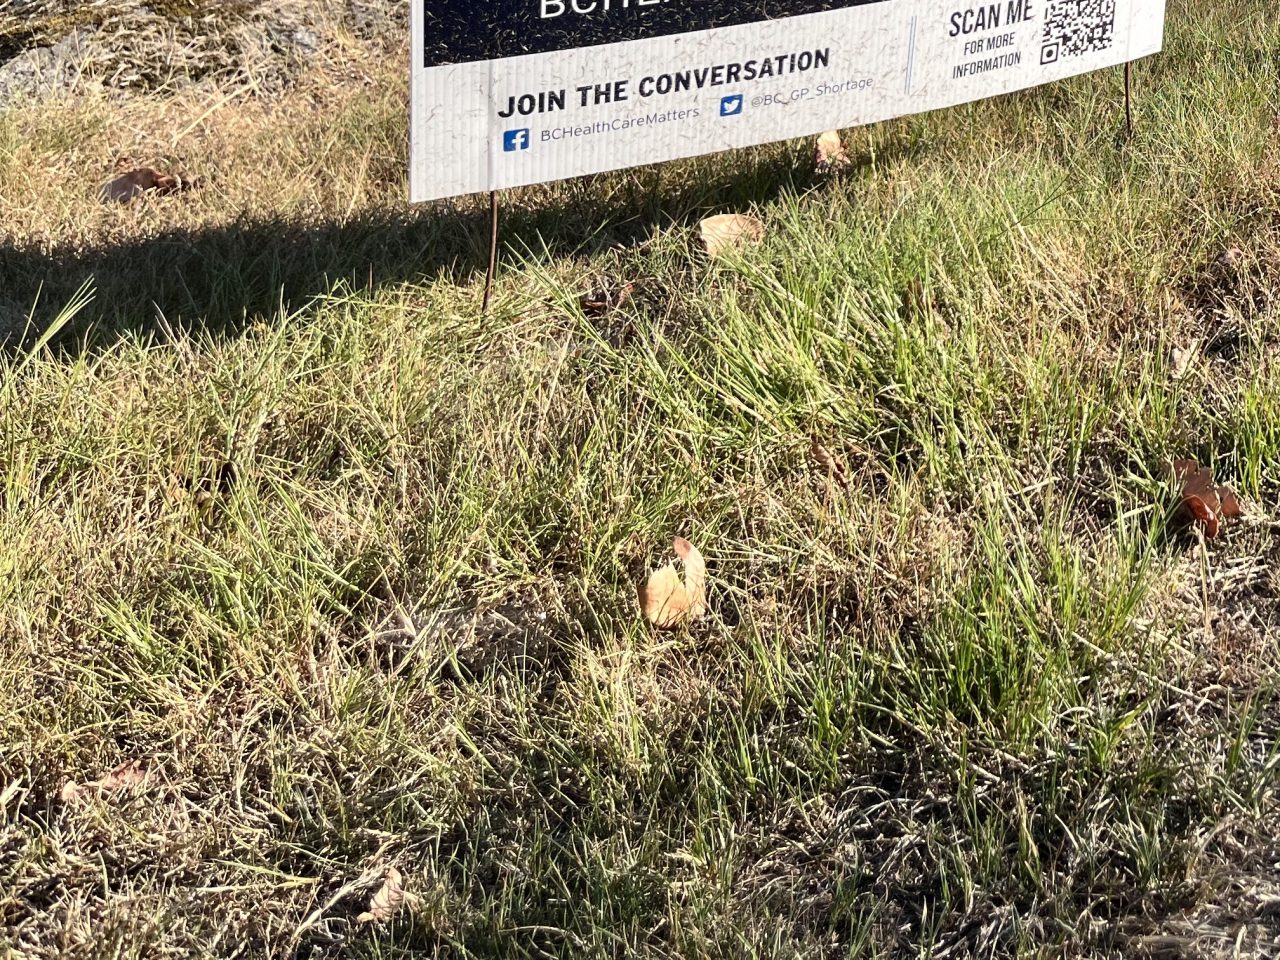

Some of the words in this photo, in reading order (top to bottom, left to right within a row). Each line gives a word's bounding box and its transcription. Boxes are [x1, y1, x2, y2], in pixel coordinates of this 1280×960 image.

[949, 3, 1001, 37] SCAN
[963, 37, 986, 56] FOR
[986, 31, 1016, 51] MORE
[952, 51, 1022, 79] INFORMATION
[497, 88, 566, 118] JOIN
[577, 79, 627, 108] THE
[638, 47, 831, 99] CONVERSATION
[750, 76, 874, 108] @BC_GP_Shortage
[541, 106, 700, 142] BCHealthCareMatters
